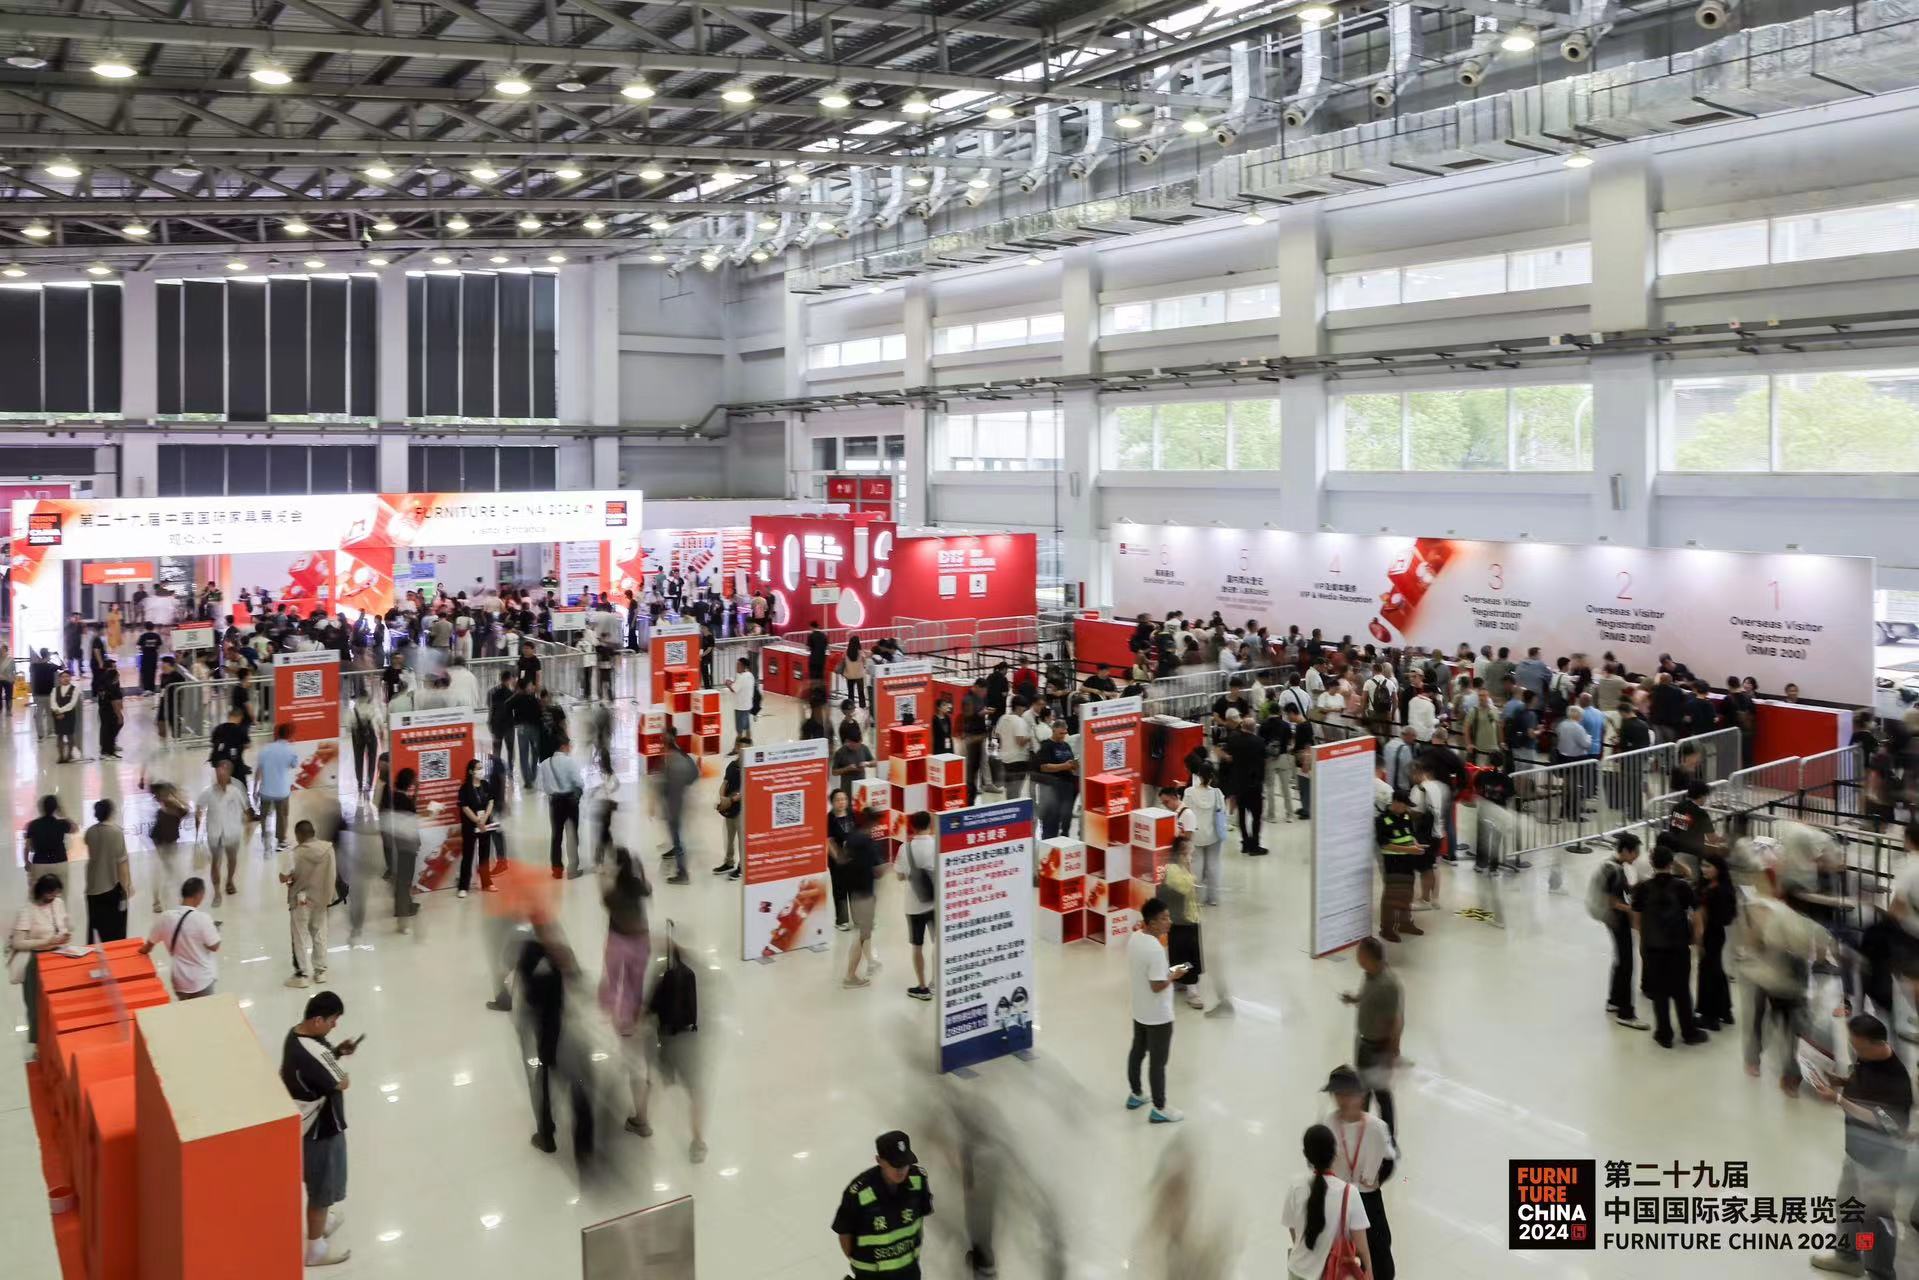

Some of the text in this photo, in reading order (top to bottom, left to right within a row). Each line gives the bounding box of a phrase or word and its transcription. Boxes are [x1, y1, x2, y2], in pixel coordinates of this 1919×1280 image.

[415, 506, 496, 519] FURNITURE
[1488, 563, 1504, 590] 3
[1616, 571, 1632, 600] 2
[1462, 594, 1532, 608] Overseas Visitor
[1767, 580, 1780, 610] 1
[1471, 607, 1522, 620] Registration
[1586, 604, 1665, 619] Overseas Visitor
[1475, 618, 1520, 632] (RMB 200)
[1596, 618, 1656, 633] Registration
[1729, 616, 1825, 632] Overseas Visitor
[1599, 630, 1652, 645] (RMB 200)
[1741, 631, 1811, 647] Registration
[1745, 645, 1807, 660] (RMB 200)
[966, 827, 1007, 845] 警方提示
[874, 1239, 914, 1259] SECURITY
